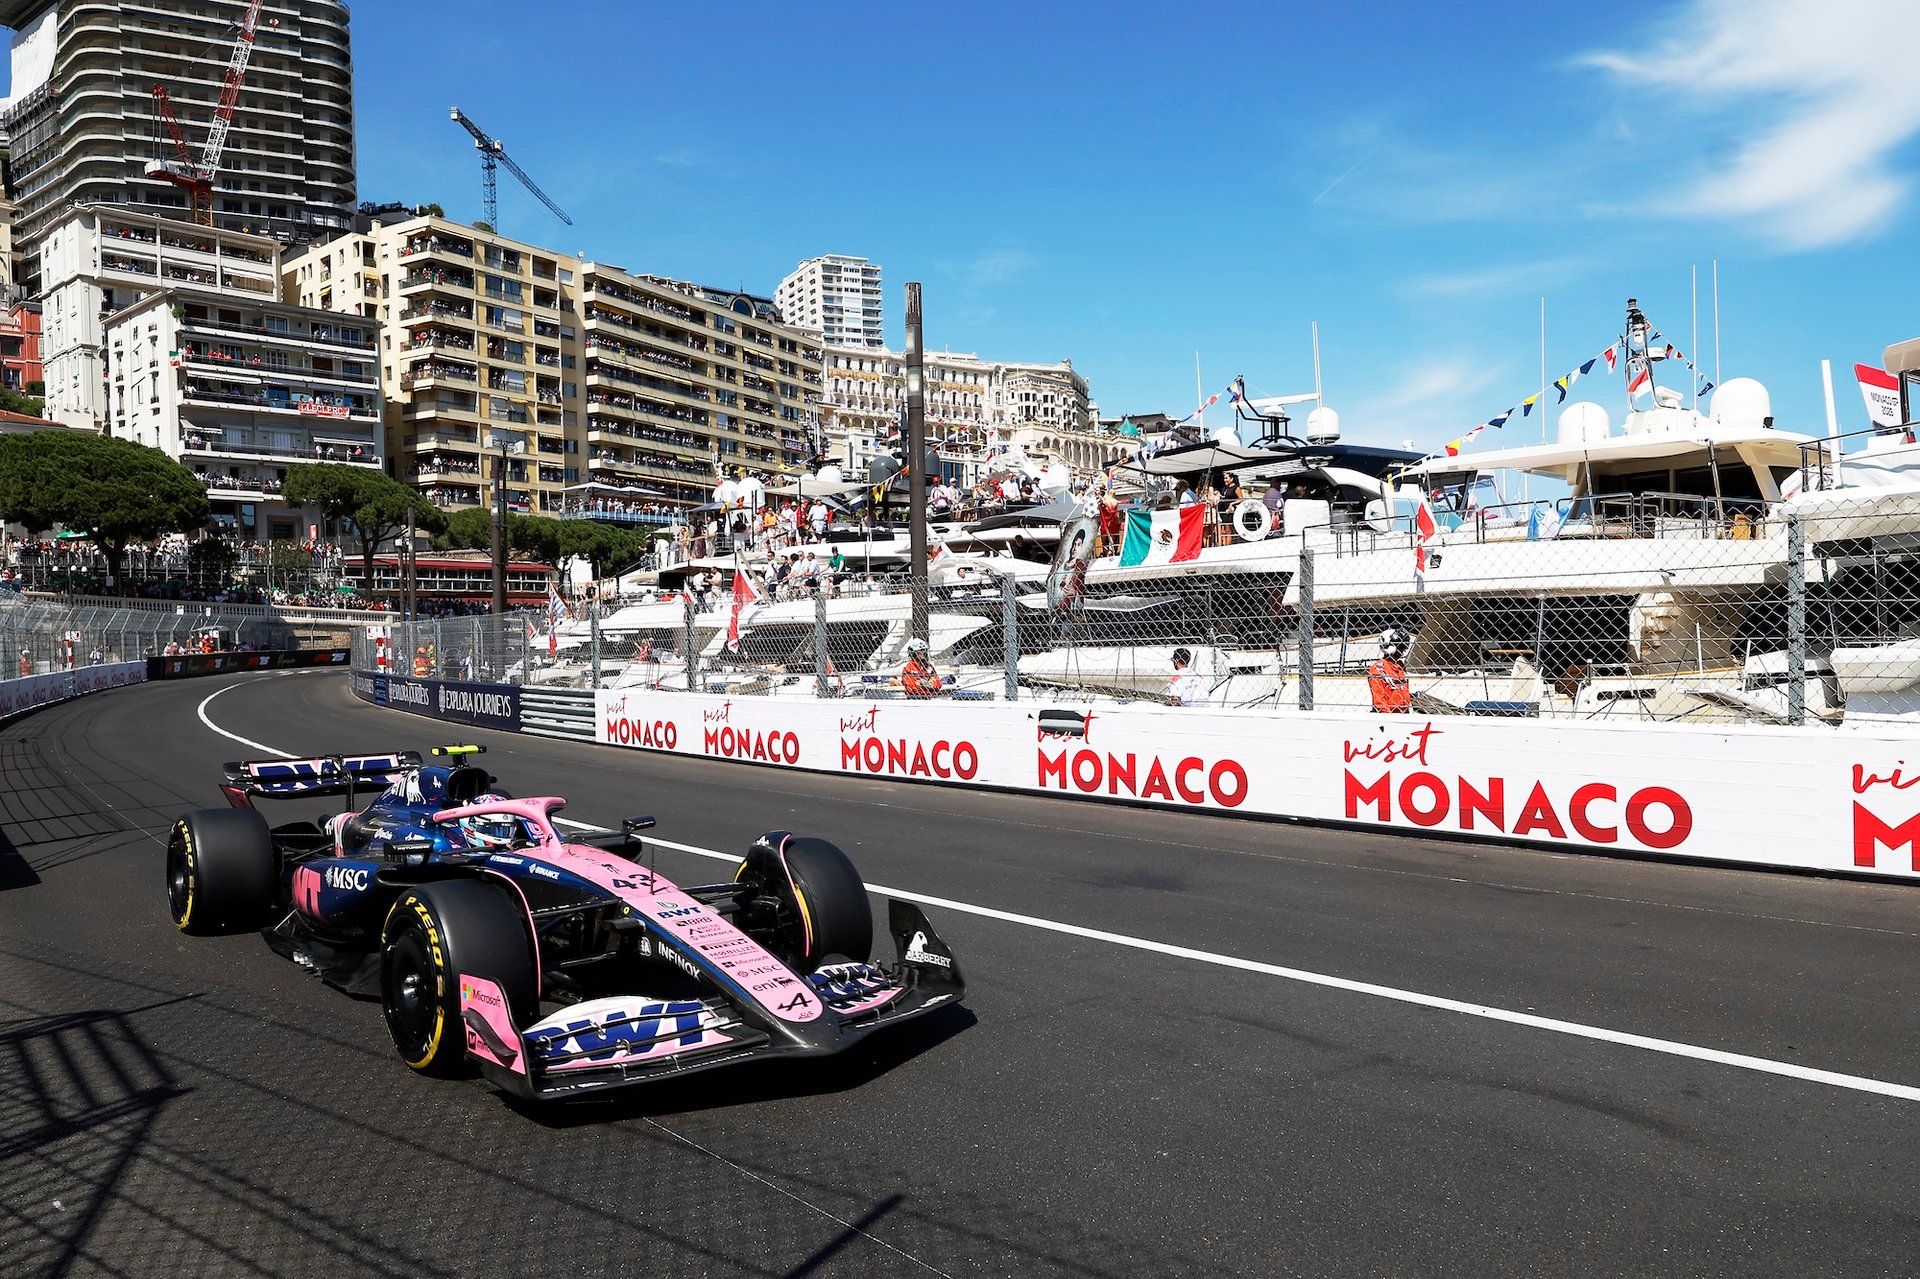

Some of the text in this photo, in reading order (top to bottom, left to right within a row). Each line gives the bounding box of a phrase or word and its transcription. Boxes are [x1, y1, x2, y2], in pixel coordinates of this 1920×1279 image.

[446, 689, 512, 718] EXPLORA JOURNEYS
[606, 694, 629, 715] visit
[703, 699, 734, 723] visit
[840, 704, 882, 733] visit
[606, 717, 677, 750] MONACO
[704, 726, 800, 765] MONACO
[1344, 722, 1444, 766] visit
[841, 736, 979, 781] MONACO
[1038, 746, 1249, 808] MONACO
[1344, 768, 1693, 849] MONACO
[332, 866, 368, 891] MSC
[535, 866, 560, 880] BINANCE
[612, 873, 658, 890] 43
[657, 906, 702, 919] BWT
[688, 916, 713, 926] BRB
[405, 896, 444, 968] P ZERO
[658, 941, 700, 981] INFINOX
[749, 963, 783, 976] MSC
[472, 988, 501, 1008] Microsoft
[752, 979, 778, 992] eni
